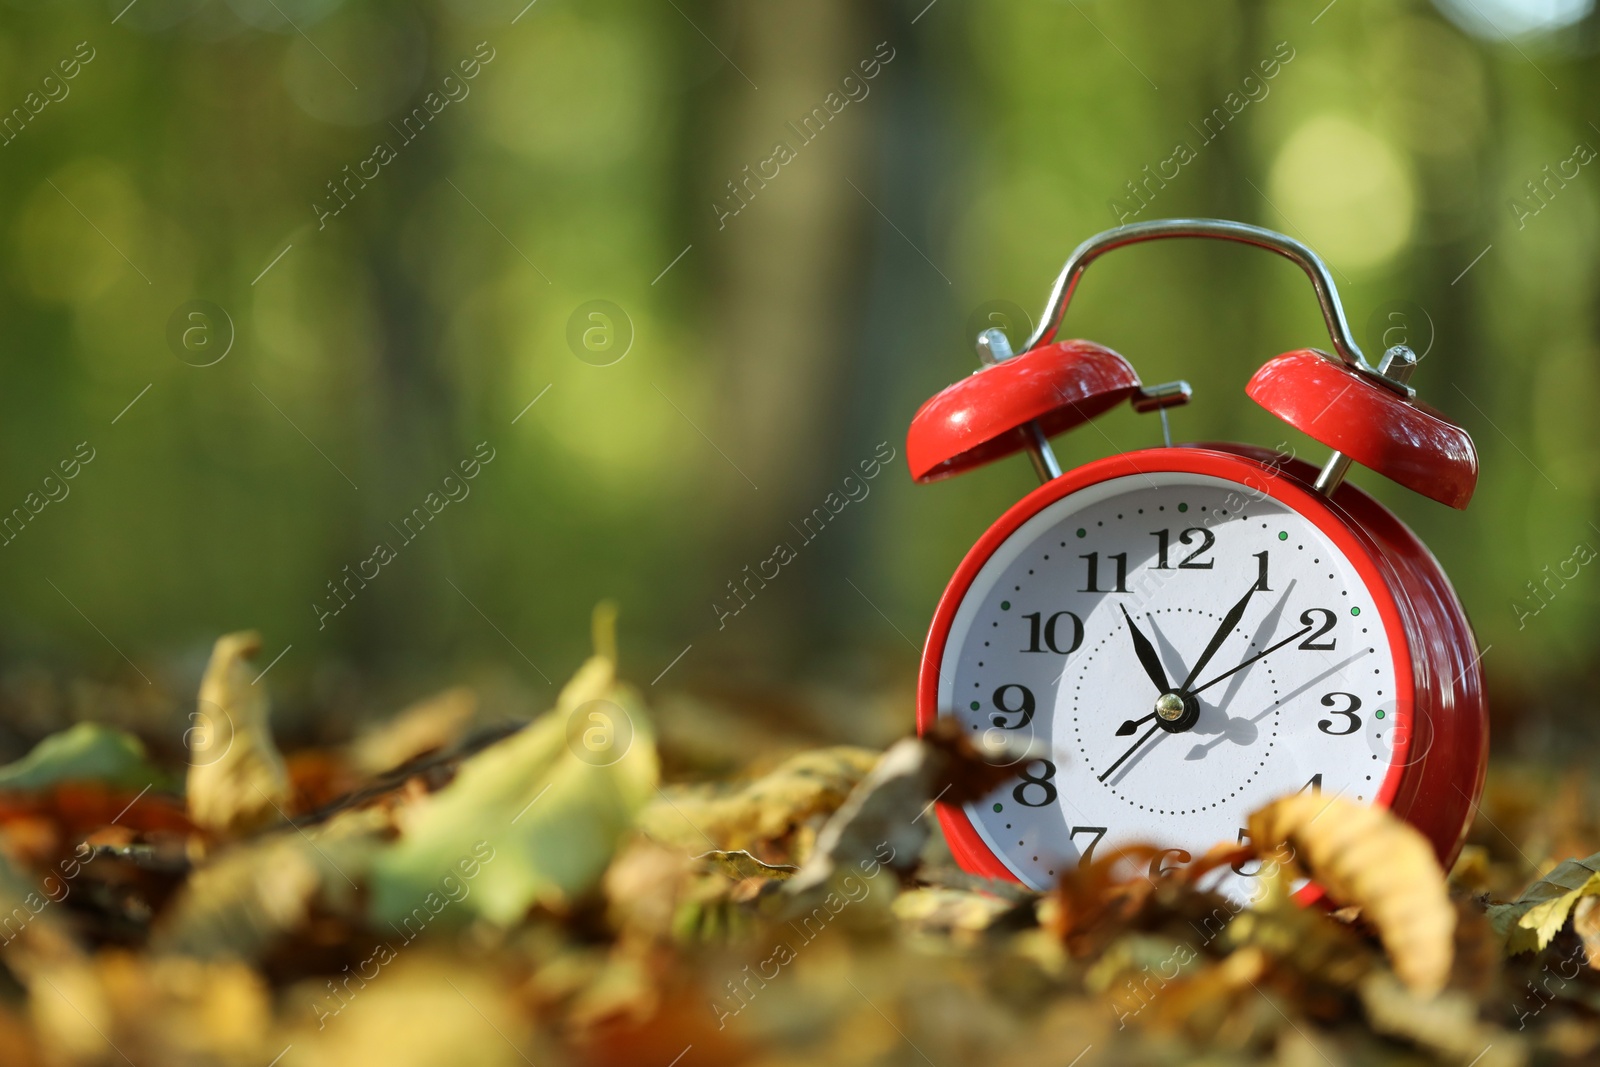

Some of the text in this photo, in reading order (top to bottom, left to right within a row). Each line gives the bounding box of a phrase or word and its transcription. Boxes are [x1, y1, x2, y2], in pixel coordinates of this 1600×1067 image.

[1148, 527, 1216, 569] 12
[1076, 551, 1135, 594] 11
[1252, 550, 1274, 592] 1
[1019, 611, 1085, 655] 10
[1298, 608, 1338, 651] 2
[992, 684, 1036, 730] 9
[1317, 691, 1363, 736] 3
[1012, 758, 1058, 808] 8
[1069, 826, 1108, 869] 7
